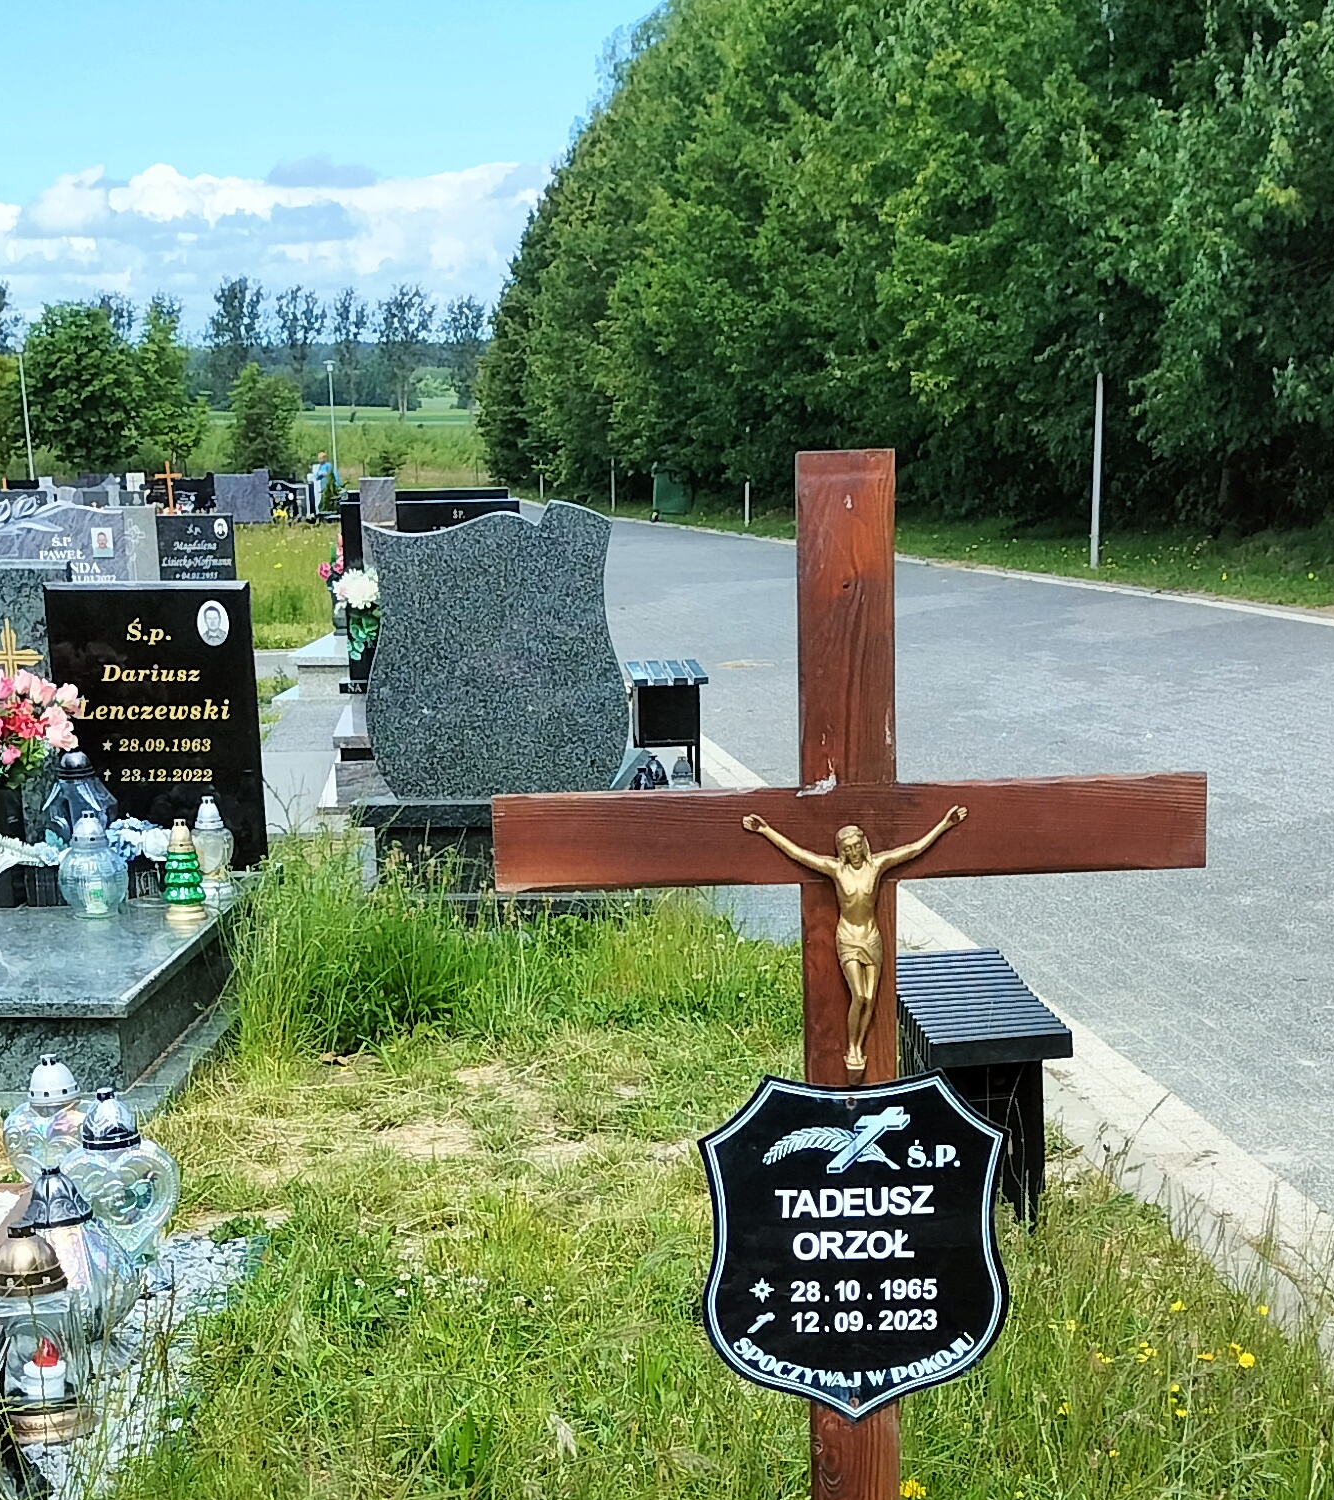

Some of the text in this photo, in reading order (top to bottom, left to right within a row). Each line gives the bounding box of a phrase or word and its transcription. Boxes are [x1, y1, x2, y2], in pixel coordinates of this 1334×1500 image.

[39, 549, 86, 560] PAWEŁ
[126, 617, 172, 646] Ś.p.
[100, 663, 201, 683] Dariusz
[76, 695, 231, 721] Lenczewski
[118, 738, 212, 753] 28.09.1963
[120, 768, 213, 783] 23.12.2022
[906, 1138, 961, 1169] Ś.P.
[774, 1184, 935, 1219] TADEUSZ
[792, 1229, 915, 1261] ORZOŁ
[732, 1331, 975, 1389] SPOCZYWAJ W POKOJU
